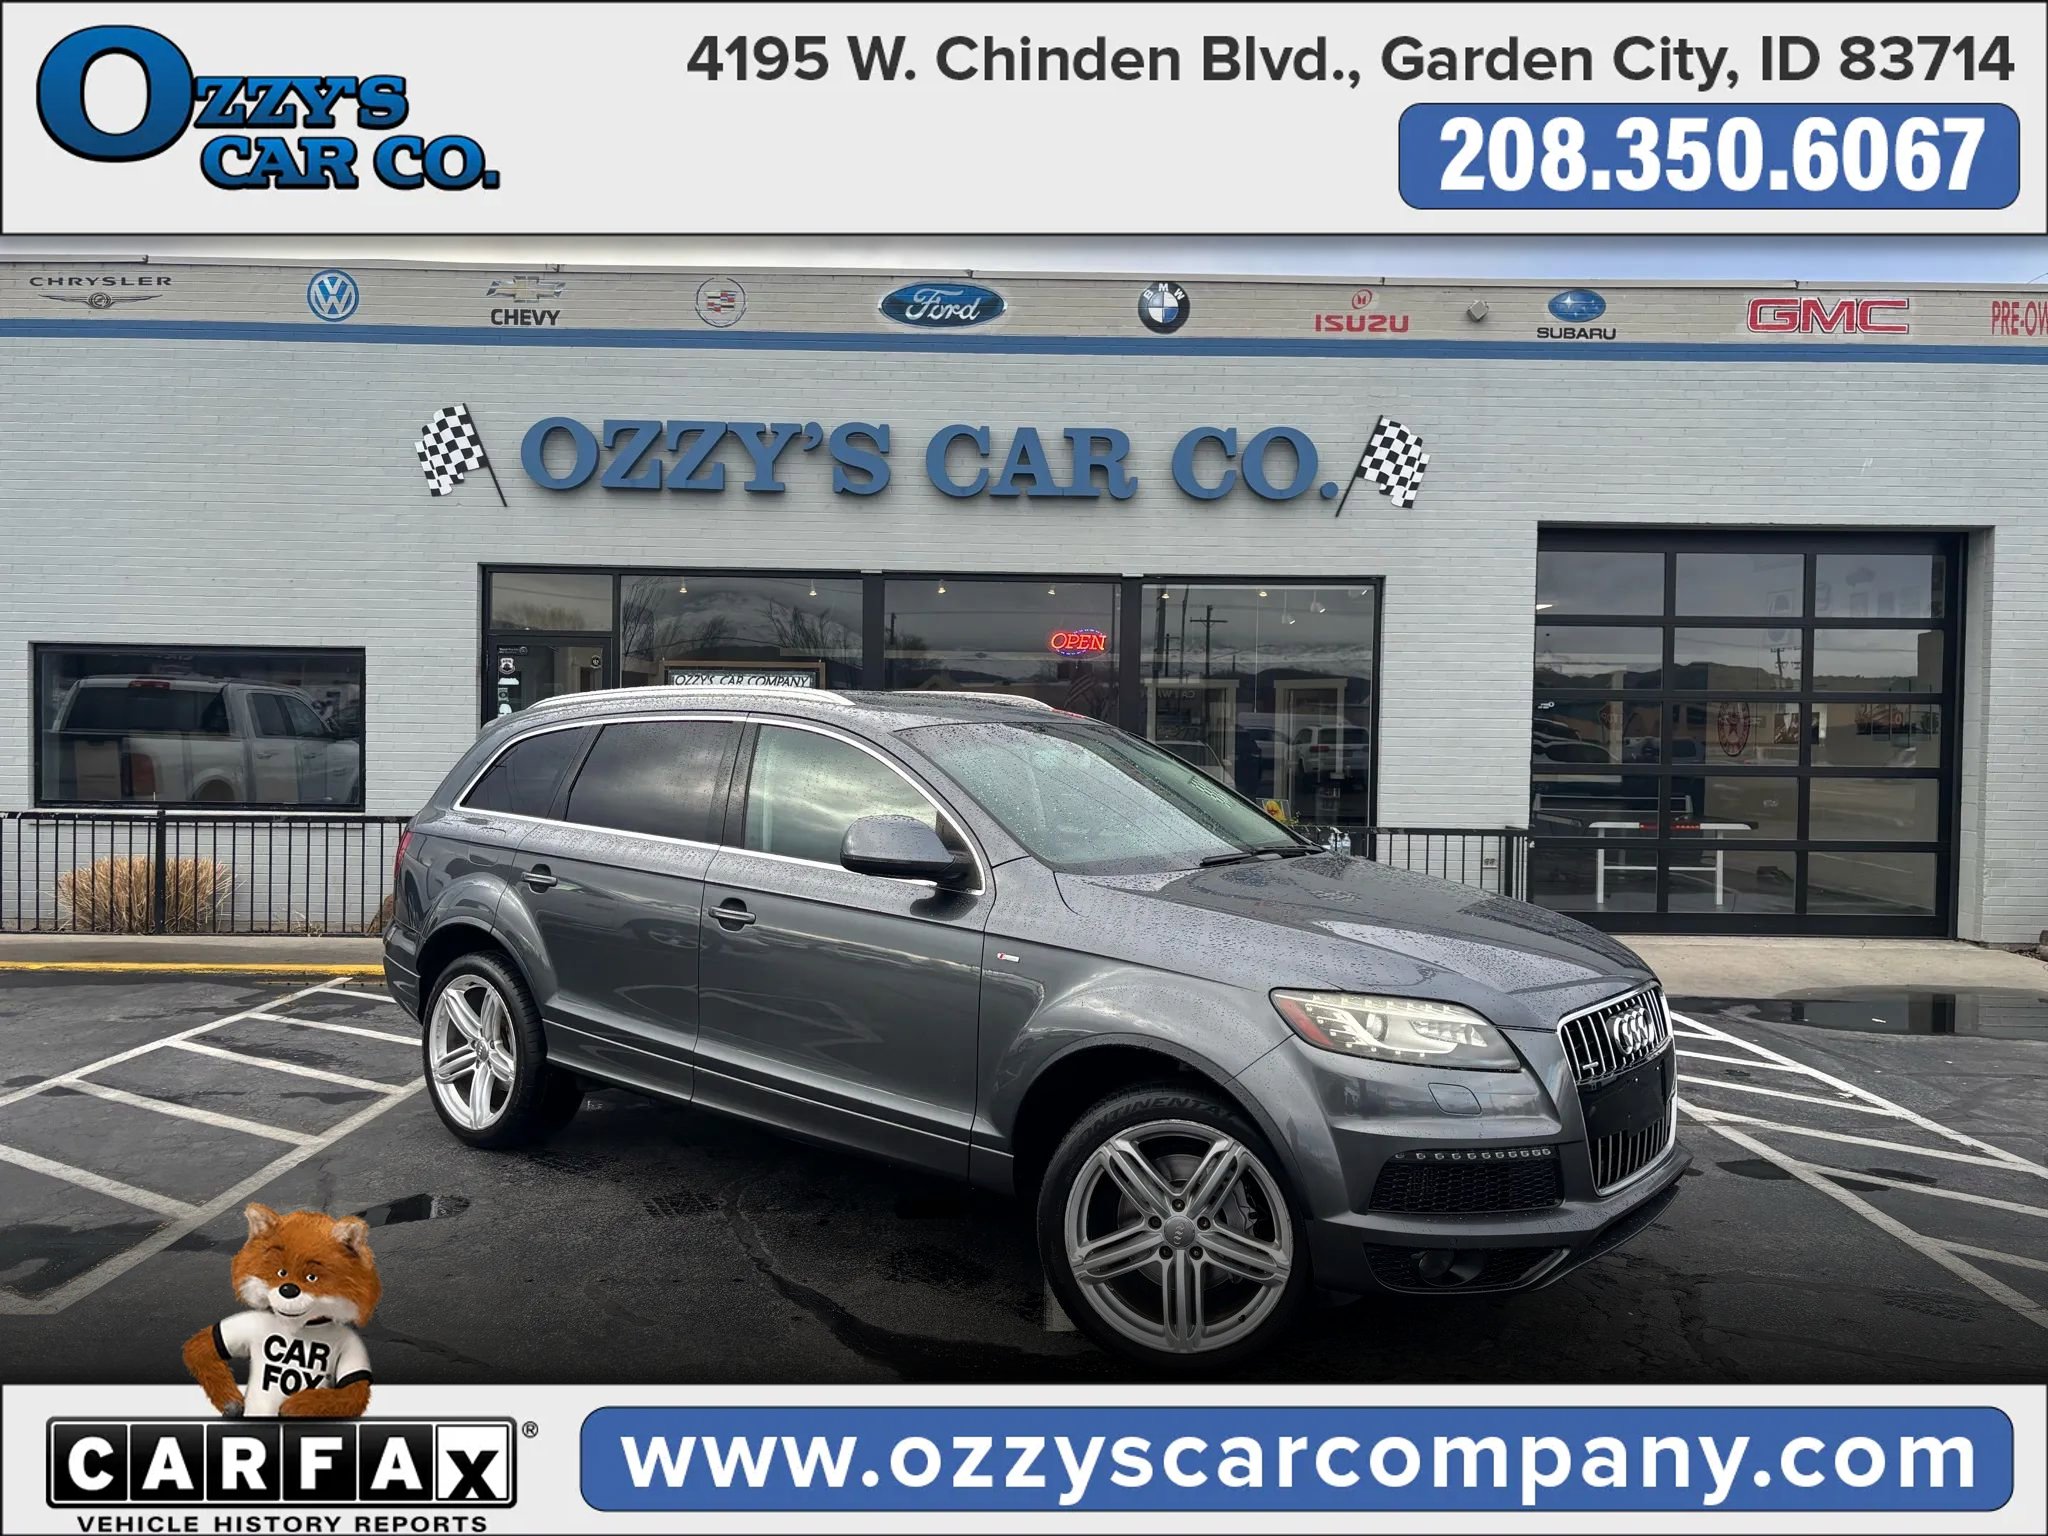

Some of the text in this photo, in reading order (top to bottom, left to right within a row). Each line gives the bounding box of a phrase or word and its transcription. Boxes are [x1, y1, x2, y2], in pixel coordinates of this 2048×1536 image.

[30, 275, 172, 287] CHRYSLER
[1143, 283, 1186, 300] BMW
[904, 288, 982, 322] Ford
[490, 309, 561, 326] CHEVY
[1312, 313, 1409, 333] ISUZU
[1746, 296, 1909, 334] GMC
[1537, 326, 1617, 341] SUBARU
[521, 416, 1339, 502] OZZY'S CAR CO.
[1051, 632, 1107, 651] OPEN
[720, 675, 743, 686] CAR
